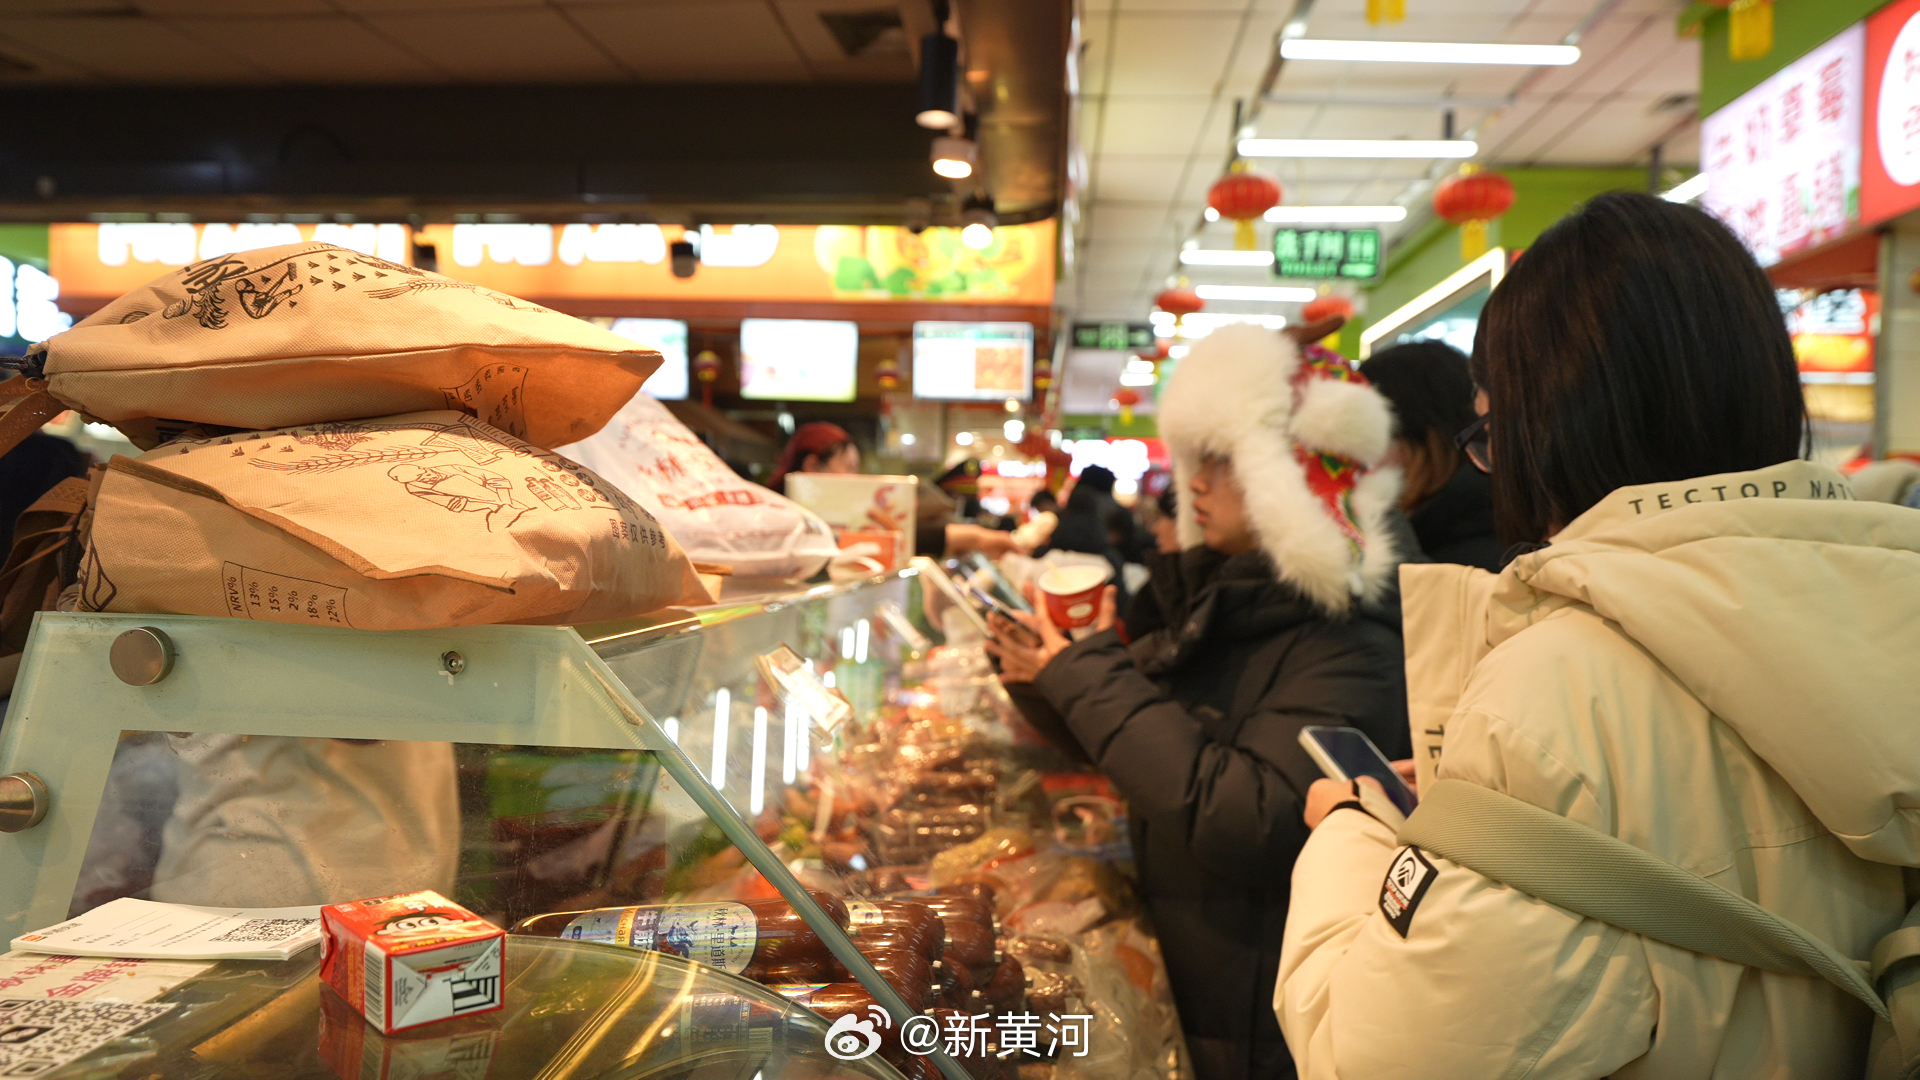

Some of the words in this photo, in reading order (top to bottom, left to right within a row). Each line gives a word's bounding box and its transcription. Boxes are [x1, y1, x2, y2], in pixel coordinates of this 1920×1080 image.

[1628, 481, 1787, 515] TECTOP
[228, 577, 242, 612] NRV%
[249, 581, 261, 607] 13%
[268, 586, 280, 612] 15%
[287, 590, 299, 611] 2%
[307, 594, 320, 619] 18%
